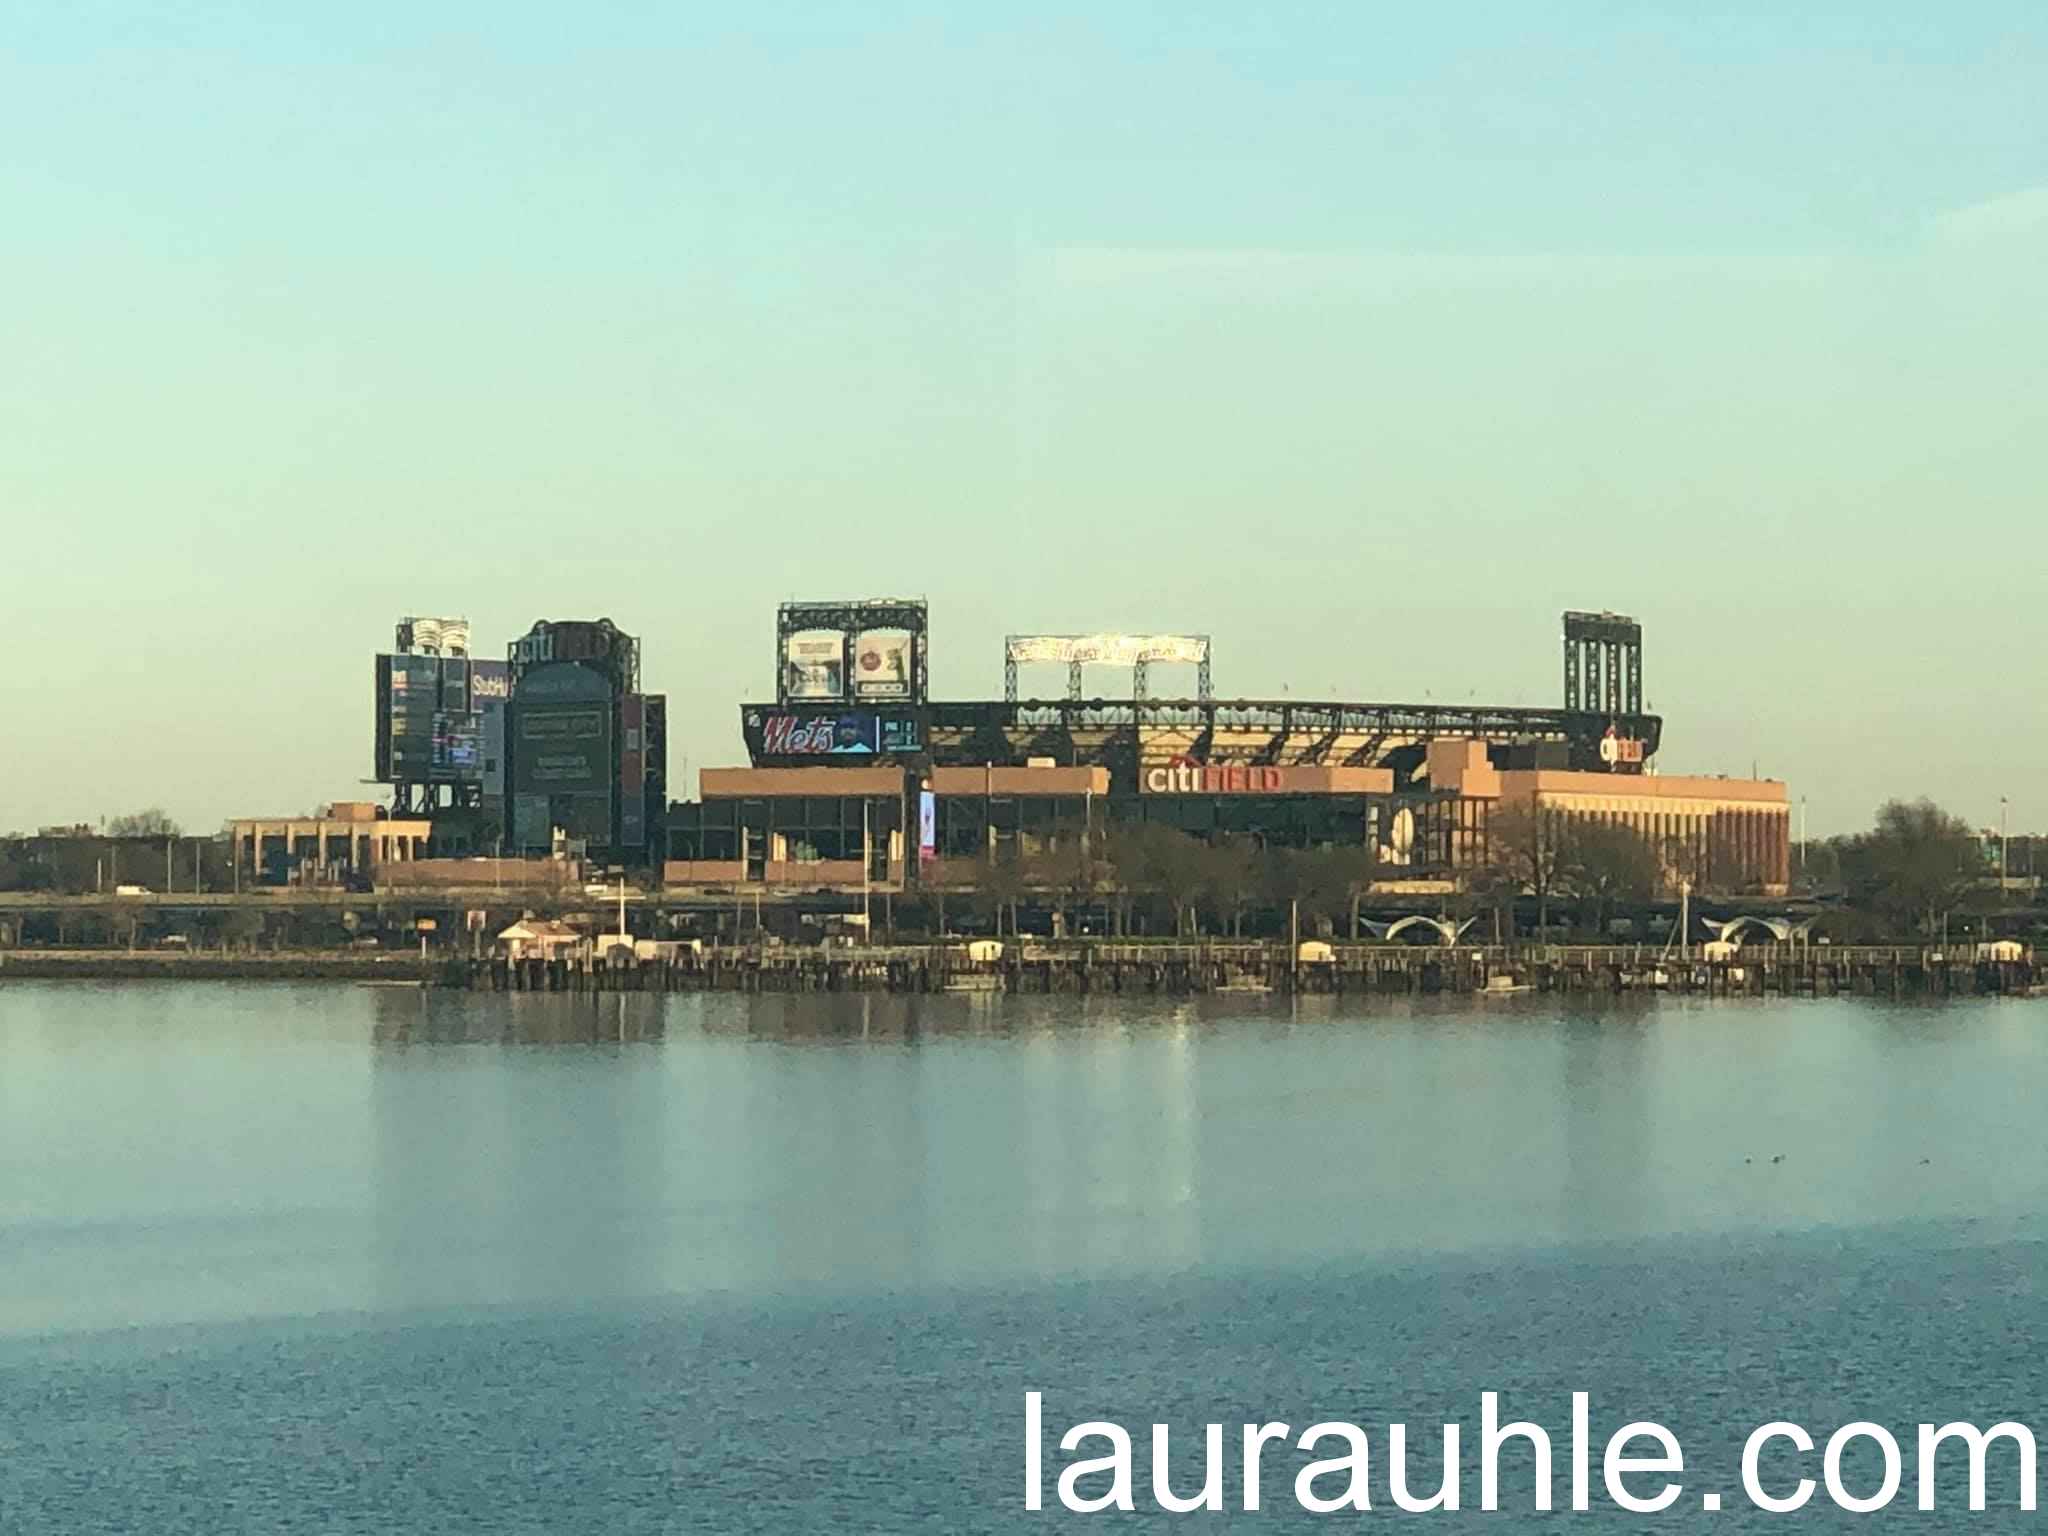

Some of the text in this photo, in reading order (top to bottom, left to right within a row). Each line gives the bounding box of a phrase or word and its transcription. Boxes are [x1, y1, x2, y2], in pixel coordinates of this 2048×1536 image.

[763, 716, 836, 753] Mets
[1147, 760, 1281, 792] citi FIELD
